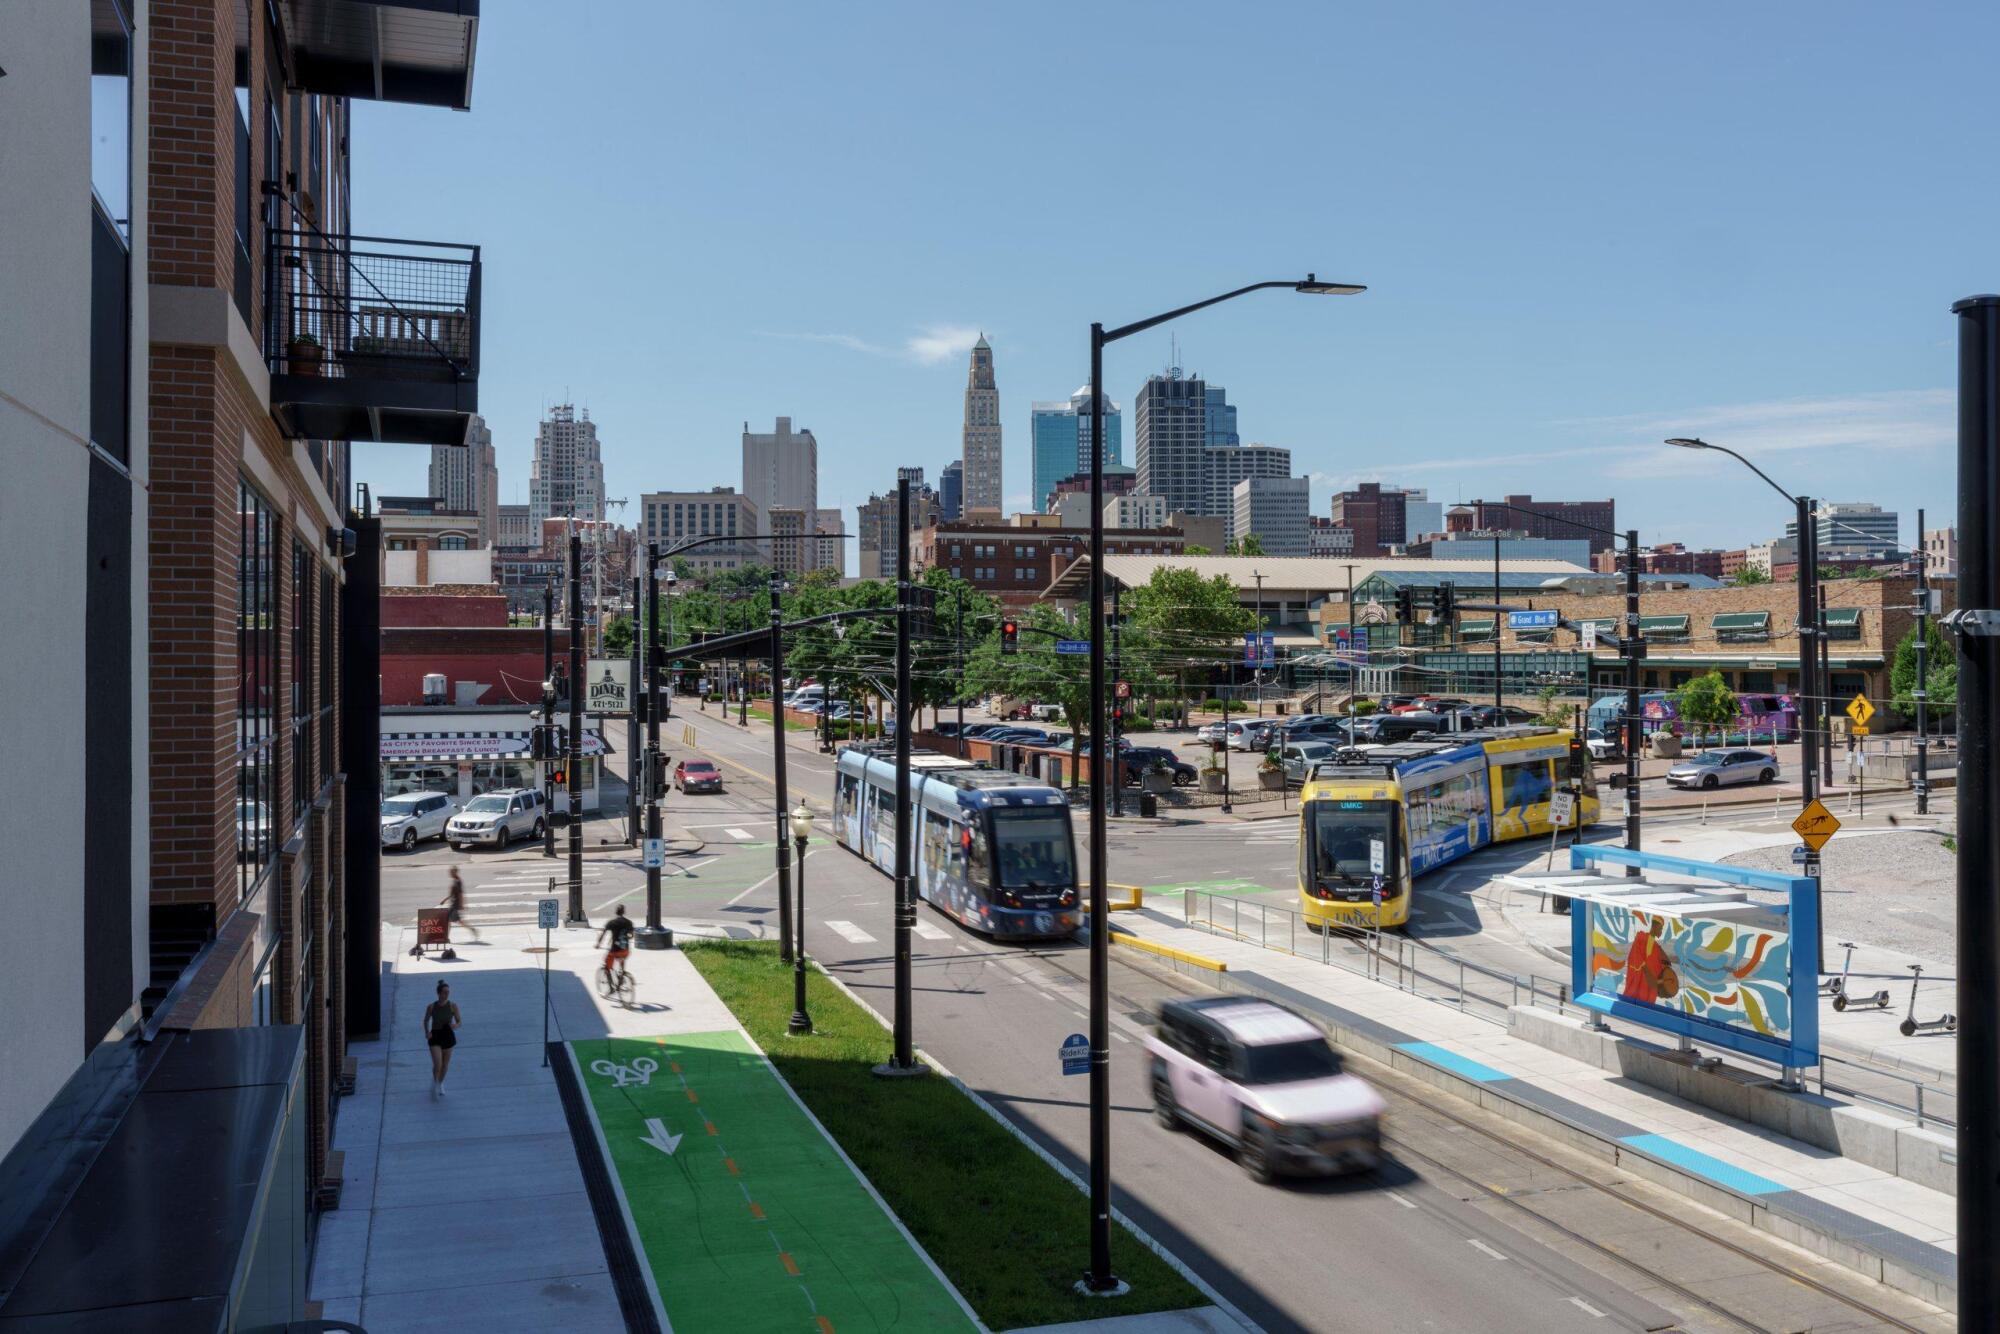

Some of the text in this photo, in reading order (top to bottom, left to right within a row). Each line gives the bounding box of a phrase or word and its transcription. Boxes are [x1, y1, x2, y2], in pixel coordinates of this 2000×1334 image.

[1517, 615, 1546, 624] Grand Blvd
[590, 683, 625, 698] DINER
[592, 700, 623, 708] 471-5121
[1555, 801, 1568, 809] TURN
[1810, 866, 1817, 875] 5
[420, 918, 439, 926] SAY
[1061, 1048, 1088, 1057] RideKC
